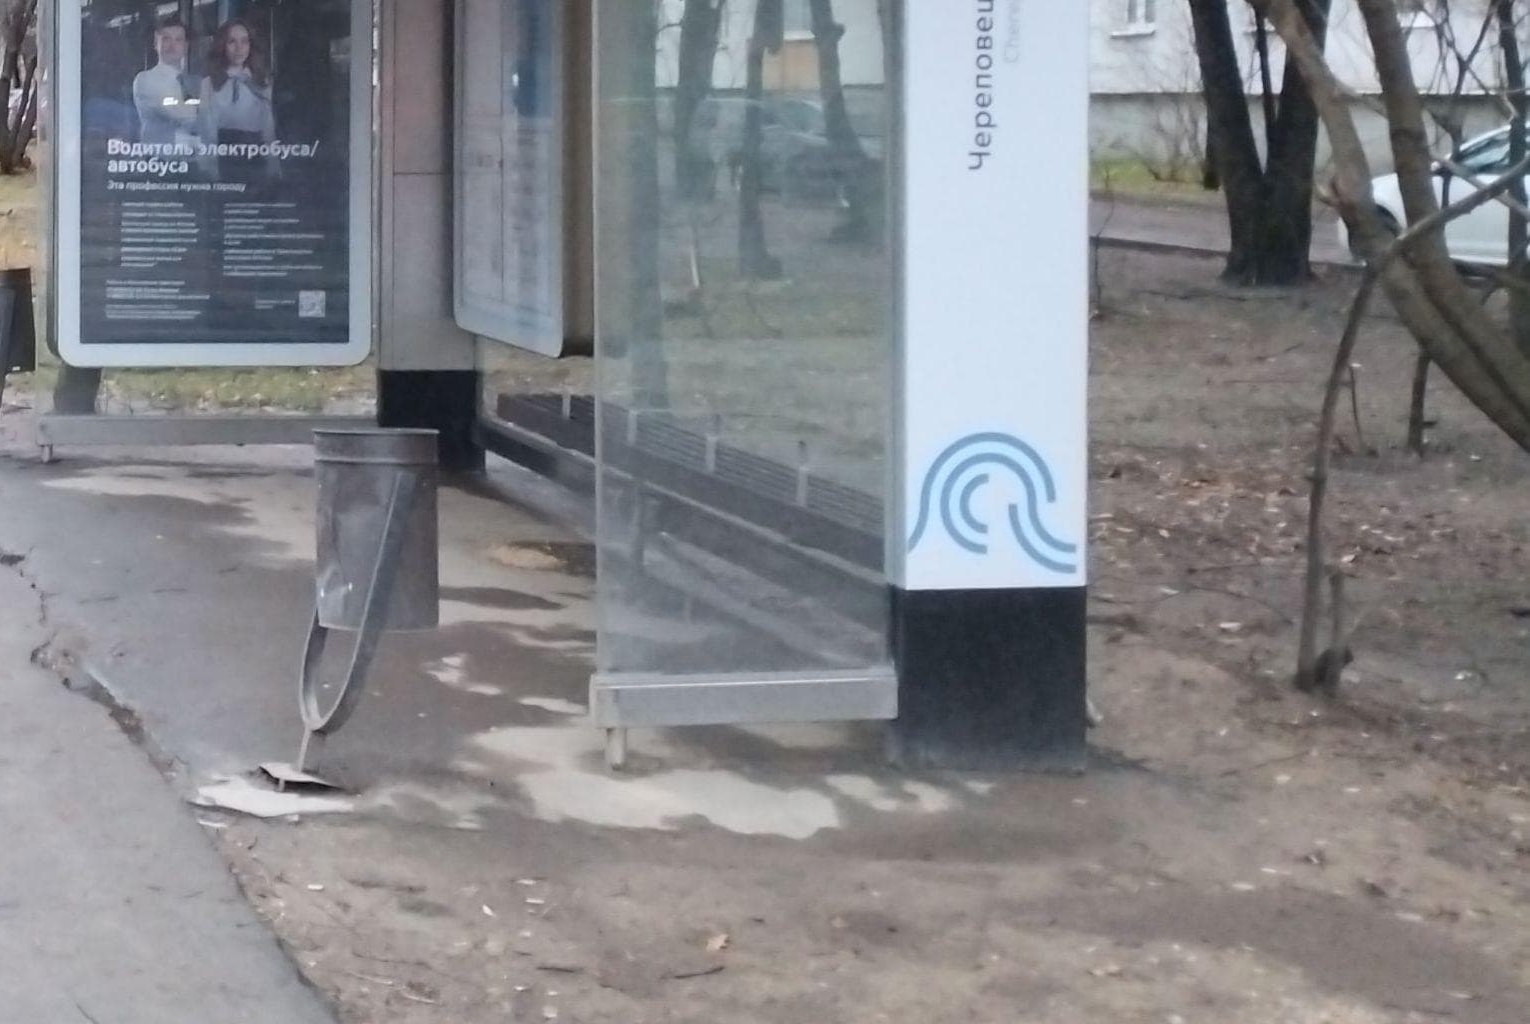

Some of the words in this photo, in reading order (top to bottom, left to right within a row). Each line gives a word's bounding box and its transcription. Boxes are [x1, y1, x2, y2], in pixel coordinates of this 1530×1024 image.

[107, 139, 194, 157] Водитель
[198, 139, 320, 160] электробуса/
[107, 158, 189, 177] автобуса
[107, 180, 124, 190] Эта
[126, 180, 178, 192] профессия
[212, 182, 246, 192] городу
